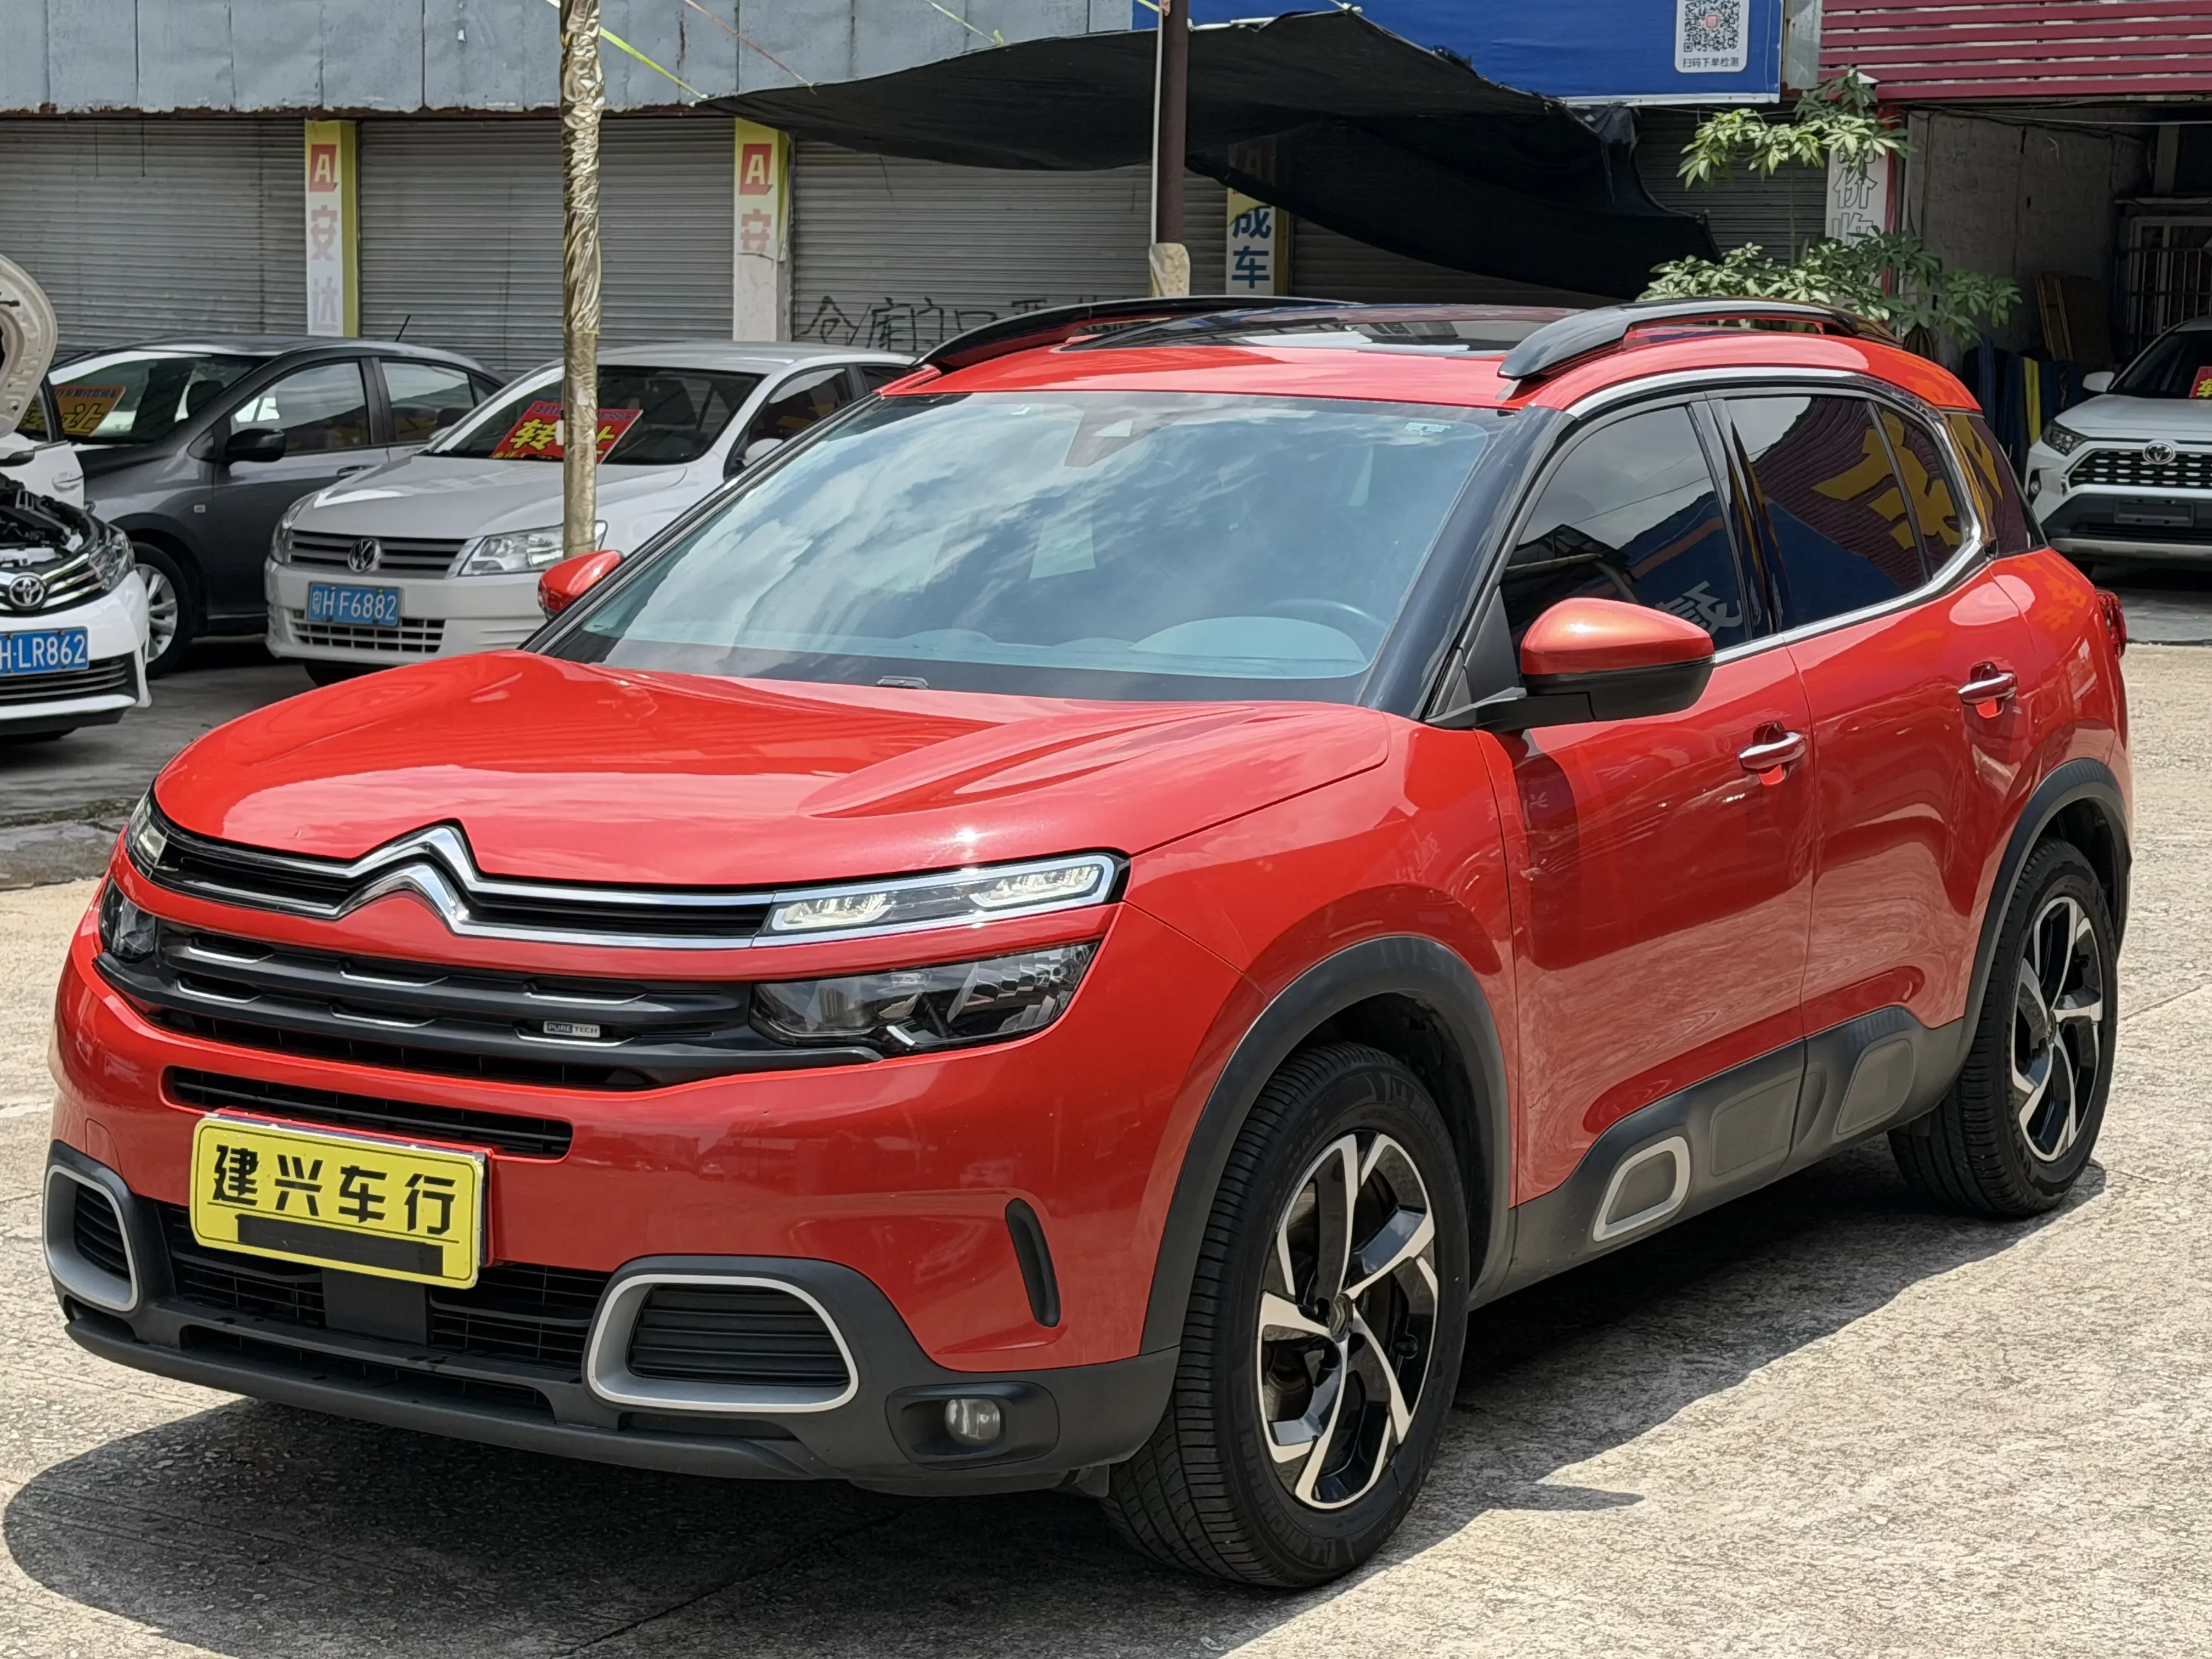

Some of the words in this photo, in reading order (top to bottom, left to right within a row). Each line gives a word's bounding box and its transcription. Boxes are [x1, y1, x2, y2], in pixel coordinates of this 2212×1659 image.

[1683, 57, 1739, 68] 扫码下单检测
[1832, 144, 1878, 249] 价收
[310, 205, 338, 331] 安达
[549, 1024, 572, 1032] PURE
[212, 1144, 456, 1235] 建兴车行
